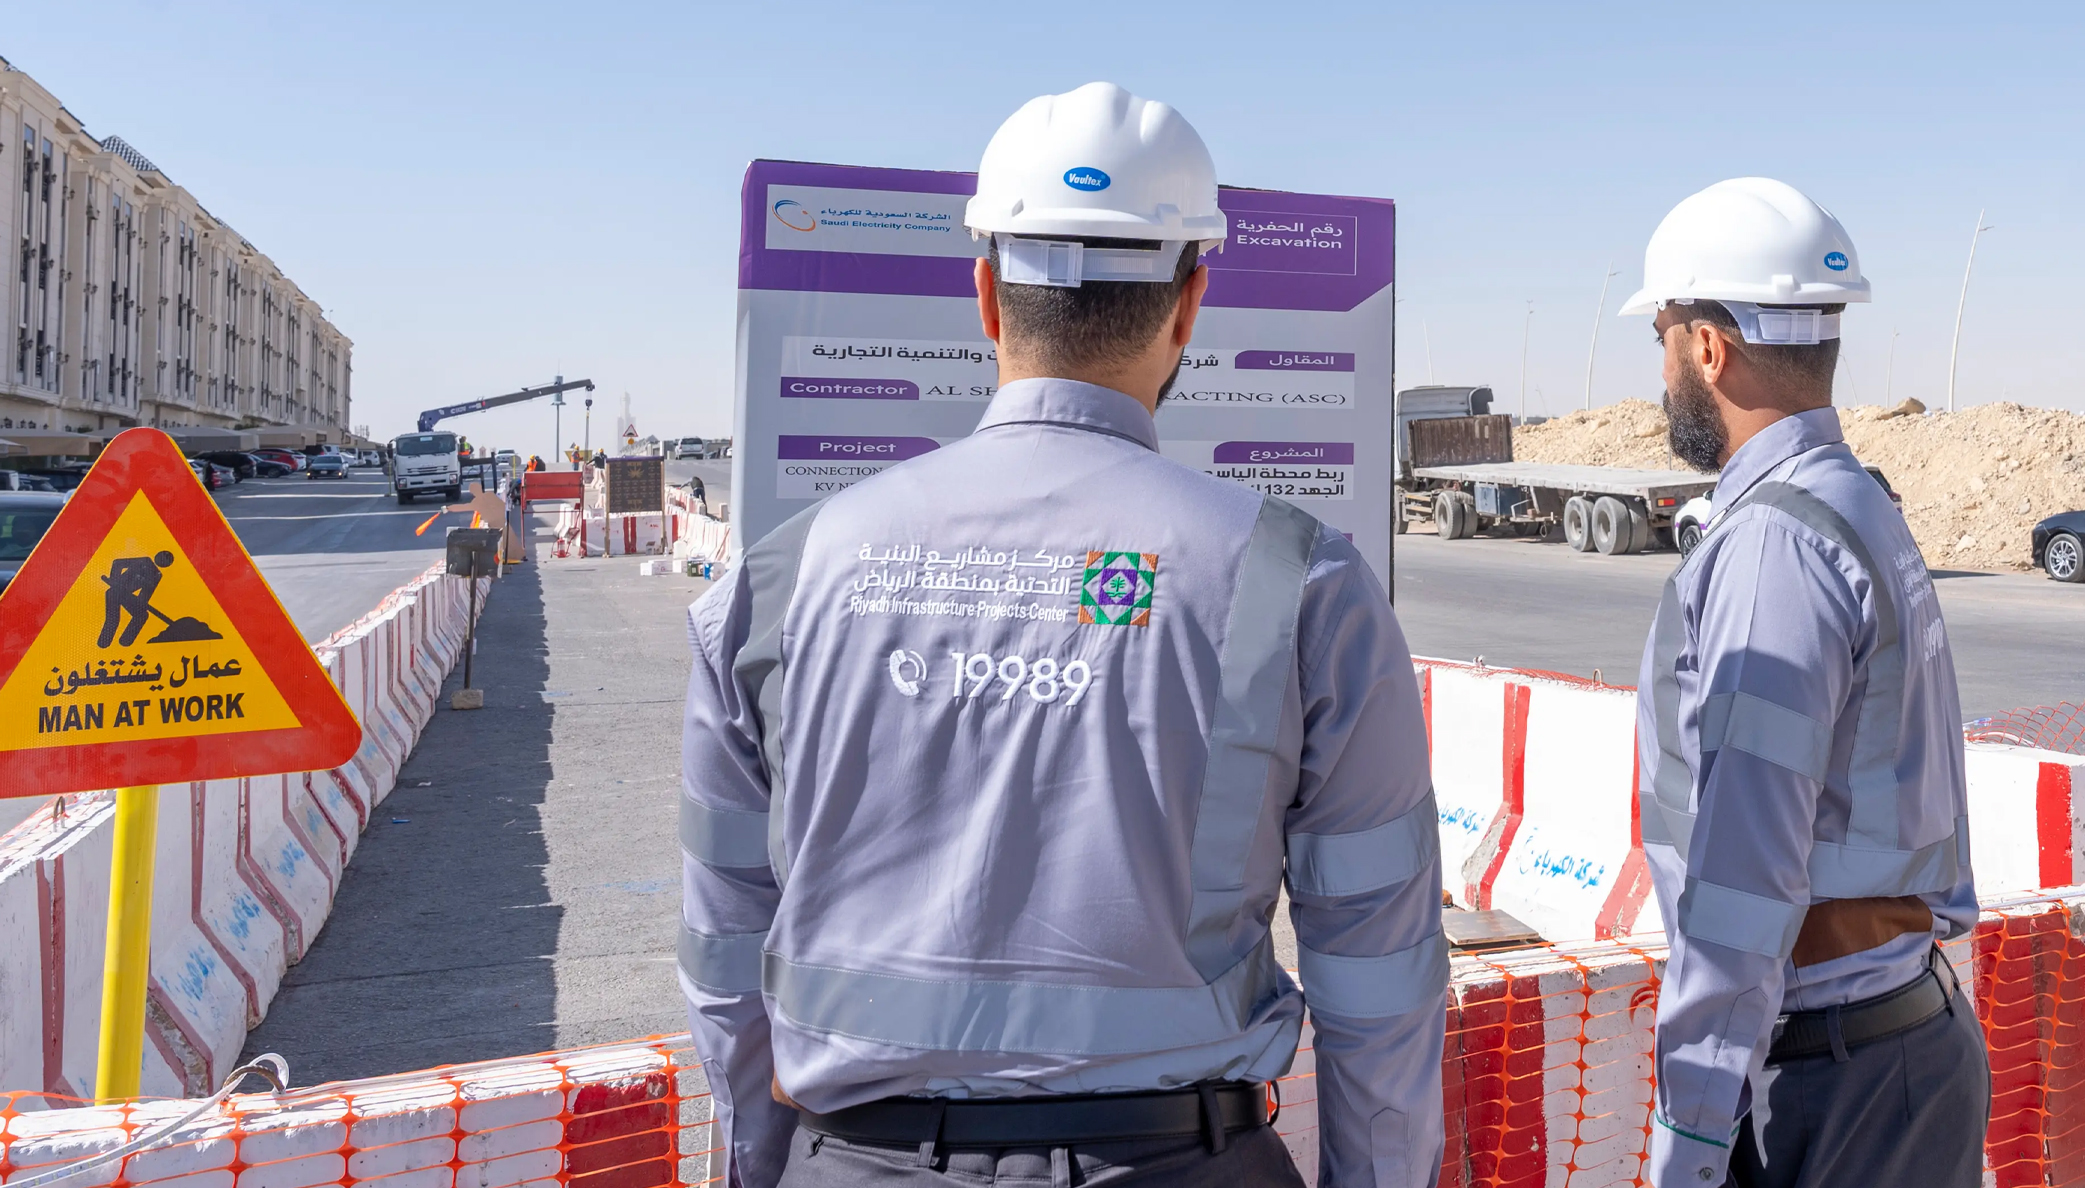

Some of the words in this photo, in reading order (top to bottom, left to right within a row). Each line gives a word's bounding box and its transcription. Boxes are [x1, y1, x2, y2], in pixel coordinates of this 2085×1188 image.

[1068, 172, 1102, 187] Vaultex
[820, 208, 862, 217] للكهرباء
[865, 209, 912, 219] السعودية
[915, 212, 951, 221] الشركة
[852, 221, 902, 230] Electricity
[904, 223, 951, 232] Company
[1236, 219, 1304, 232] الحفرية
[1310, 223, 1343, 237] رقم
[1236, 234, 1342, 249] Excavation
[812, 344, 892, 361] التجارية
[896, 346, 983, 363] والتنمية
[1269, 354, 1334, 366] المقاول
[789, 382, 908, 395] Contractor
[925, 385, 962, 396] AL
[1281, 393, 1346, 405] (ASC)
[819, 441, 897, 455] Project
[1249, 447, 1324, 461] المشروع
[1259, 467, 1312, 479] محطة
[1315, 468, 1344, 482] ربط
[815, 482, 835, 491] KV
[1264, 484, 1295, 495] 132
[1298, 484, 1344, 499] الجهد
[858, 543, 921, 565] البنية
[923, 545, 1007, 571] مشاريع
[1008, 548, 1075, 573] مركز
[853, 568, 917, 593] الرياض
[920, 571, 1000, 596] بمنطقة
[1004, 574, 1072, 597] التحتية
[849, 595, 890, 617] Riyadh
[891, 597, 977, 618] Infrastructure
[976, 600, 1028, 622] Projects
[1029, 604, 1070, 622] Center
[43, 653, 165, 697] يشتغلون
[169, 654, 242, 688] عمال
[951, 652, 1092, 706] 19989
[38, 702, 104, 734] MAN
[113, 699, 151, 728] AT
[159, 692, 245, 724] WORK
